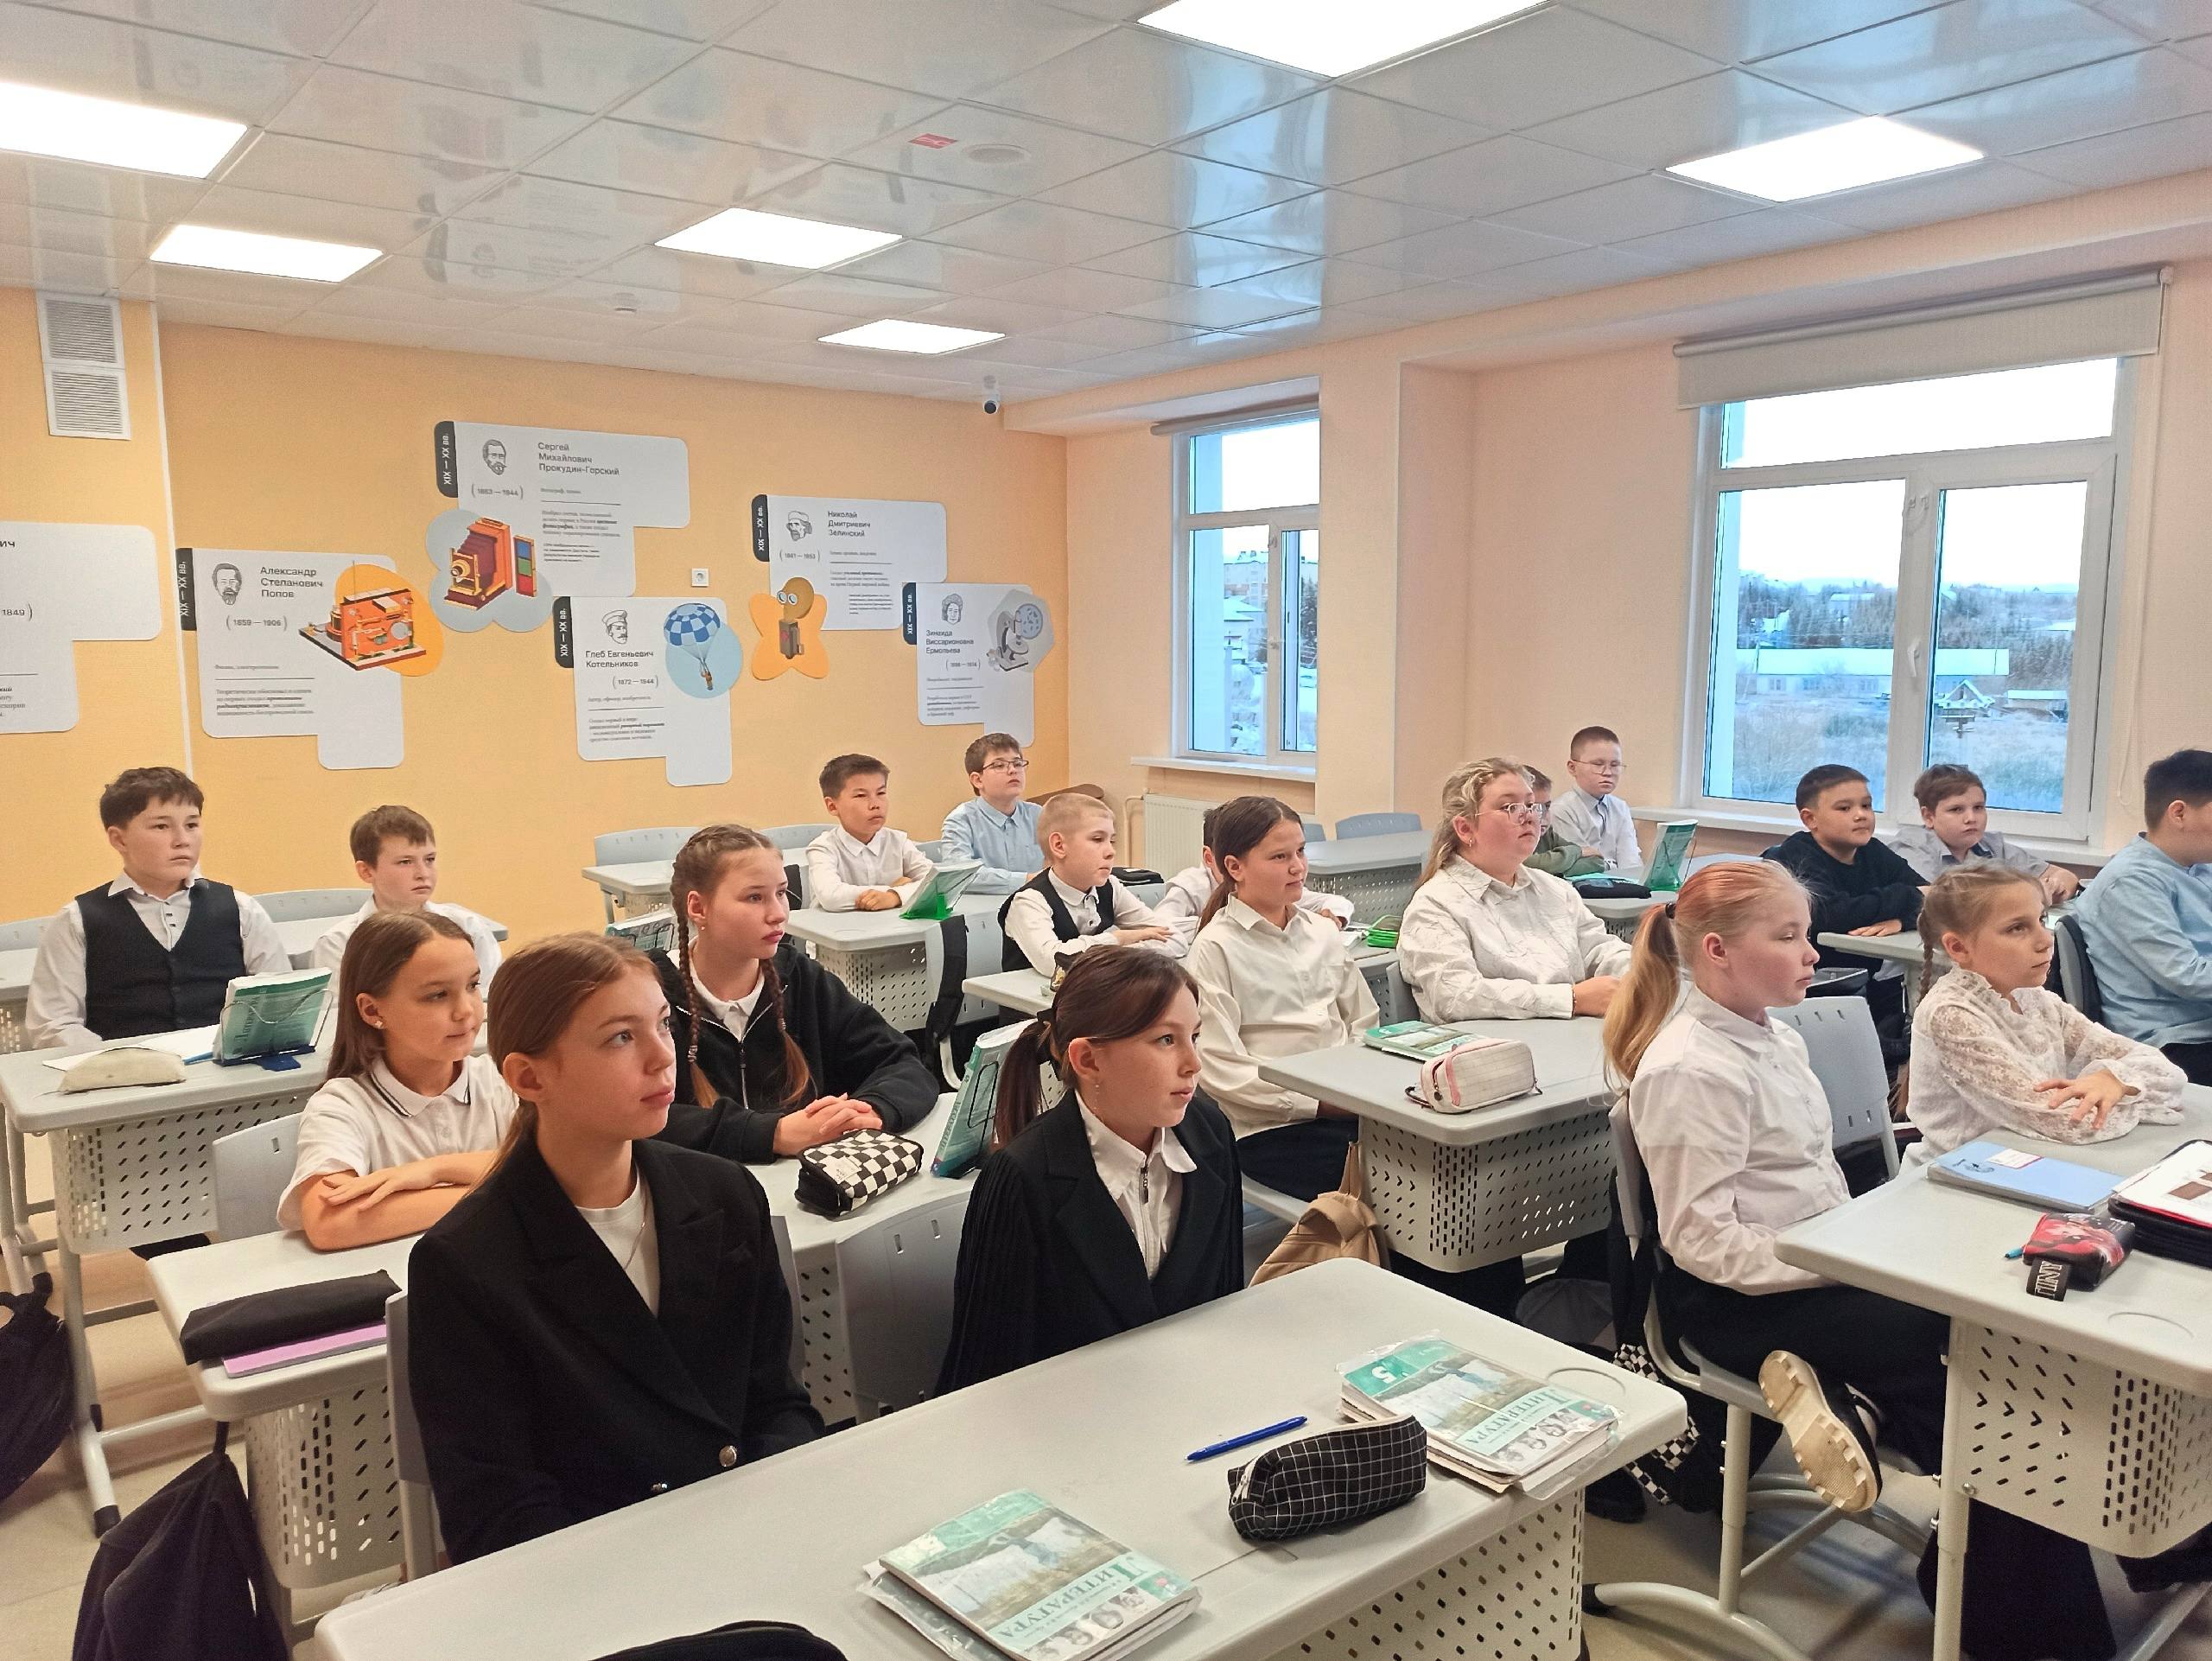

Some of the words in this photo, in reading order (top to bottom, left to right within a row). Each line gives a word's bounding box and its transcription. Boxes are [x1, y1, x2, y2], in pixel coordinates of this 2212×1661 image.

[537, 442, 569, 452] Сергей
[442, 447, 450, 459] XX
[538, 453, 593, 464] Михайлович
[539, 463, 620, 476] Прокудин-Горский
[443, 471, 452, 485] XIX
[757, 518, 764, 528] XX
[828, 520, 871, 529] Дмитриевич
[829, 529, 865, 538] Зелинский
[260, 565, 317, 577] Александр
[177, 576, 188, 589] XX
[260, 577, 323, 588] Степанович
[261, 589, 295, 599] Попов
[179, 602, 189, 616] XIX
[906, 604, 912, 614] XX
[559, 621, 567, 632] XX
[560, 644, 569, 657] XIX
[607, 650, 654, 659] Евгеньевич
[998, 1556, 1148, 1638] ЛИТЕРАТУРА
